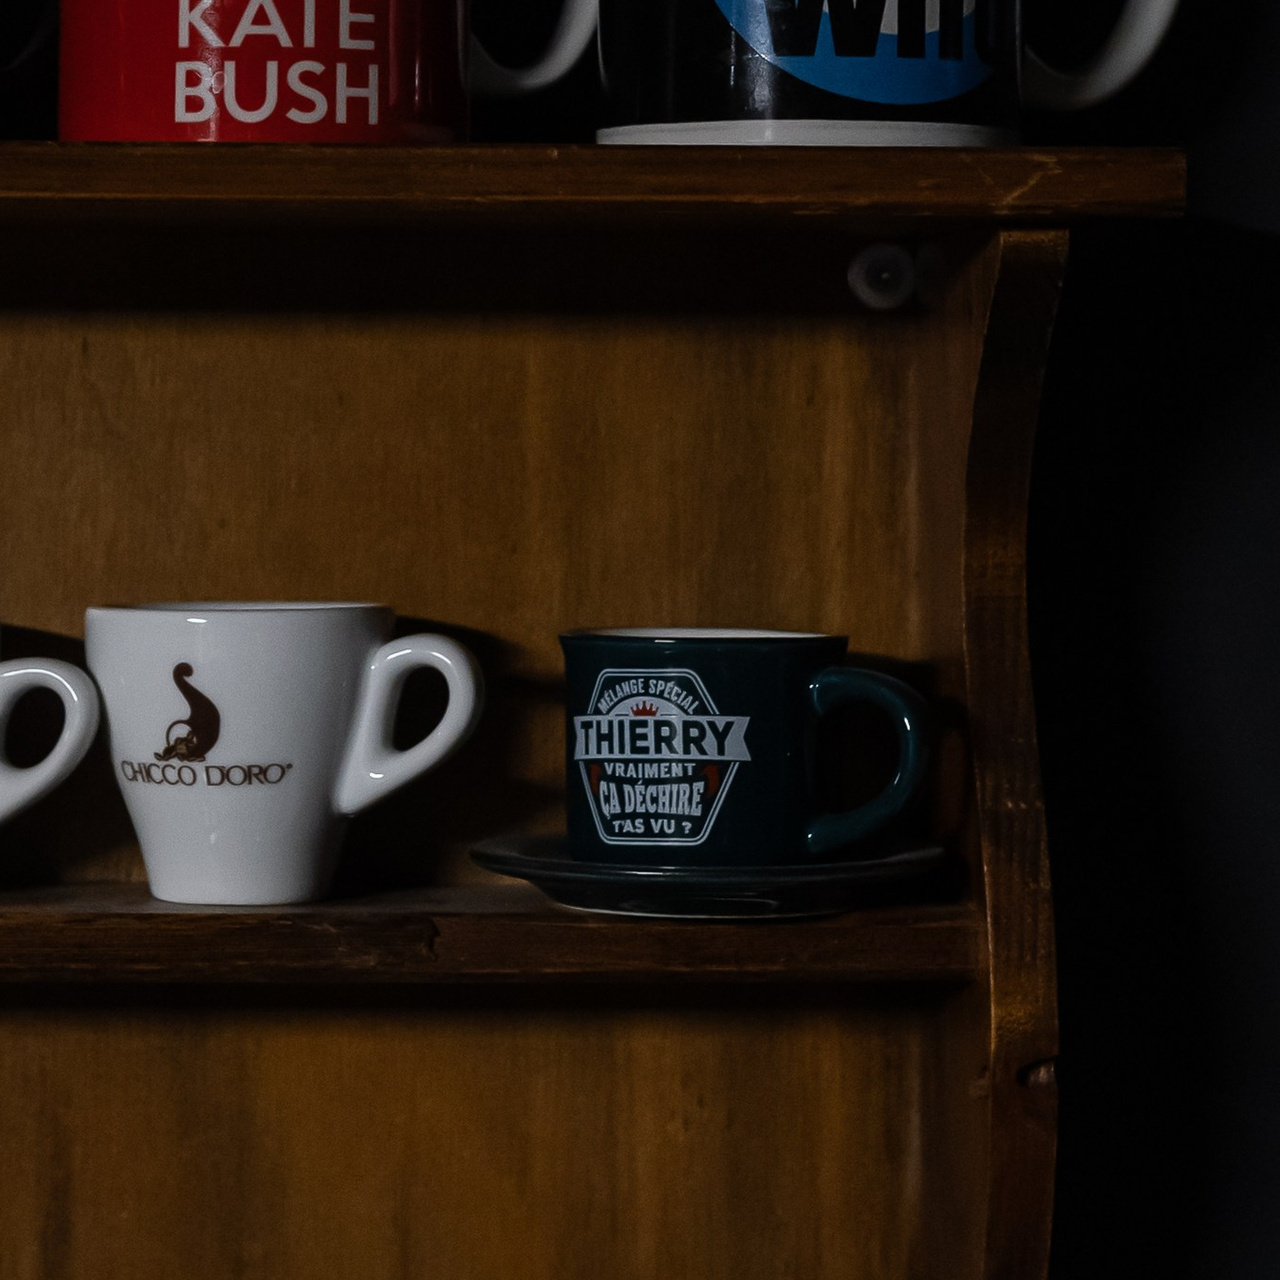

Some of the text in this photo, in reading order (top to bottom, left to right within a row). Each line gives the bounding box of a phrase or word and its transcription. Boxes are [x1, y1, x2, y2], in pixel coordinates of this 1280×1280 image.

[174, 59, 379, 125] BUSH
[597, 678, 700, 715] MÉLANGE SPÉCIAL
[580, 720, 734, 756] THIERRY
[121, 760, 197, 786] CHICCO
[604, 762, 696, 778] VRAIMENT
[599, 779, 705, 819] ÇA DÉCHIRE
[650, 819, 675, 834] VU
